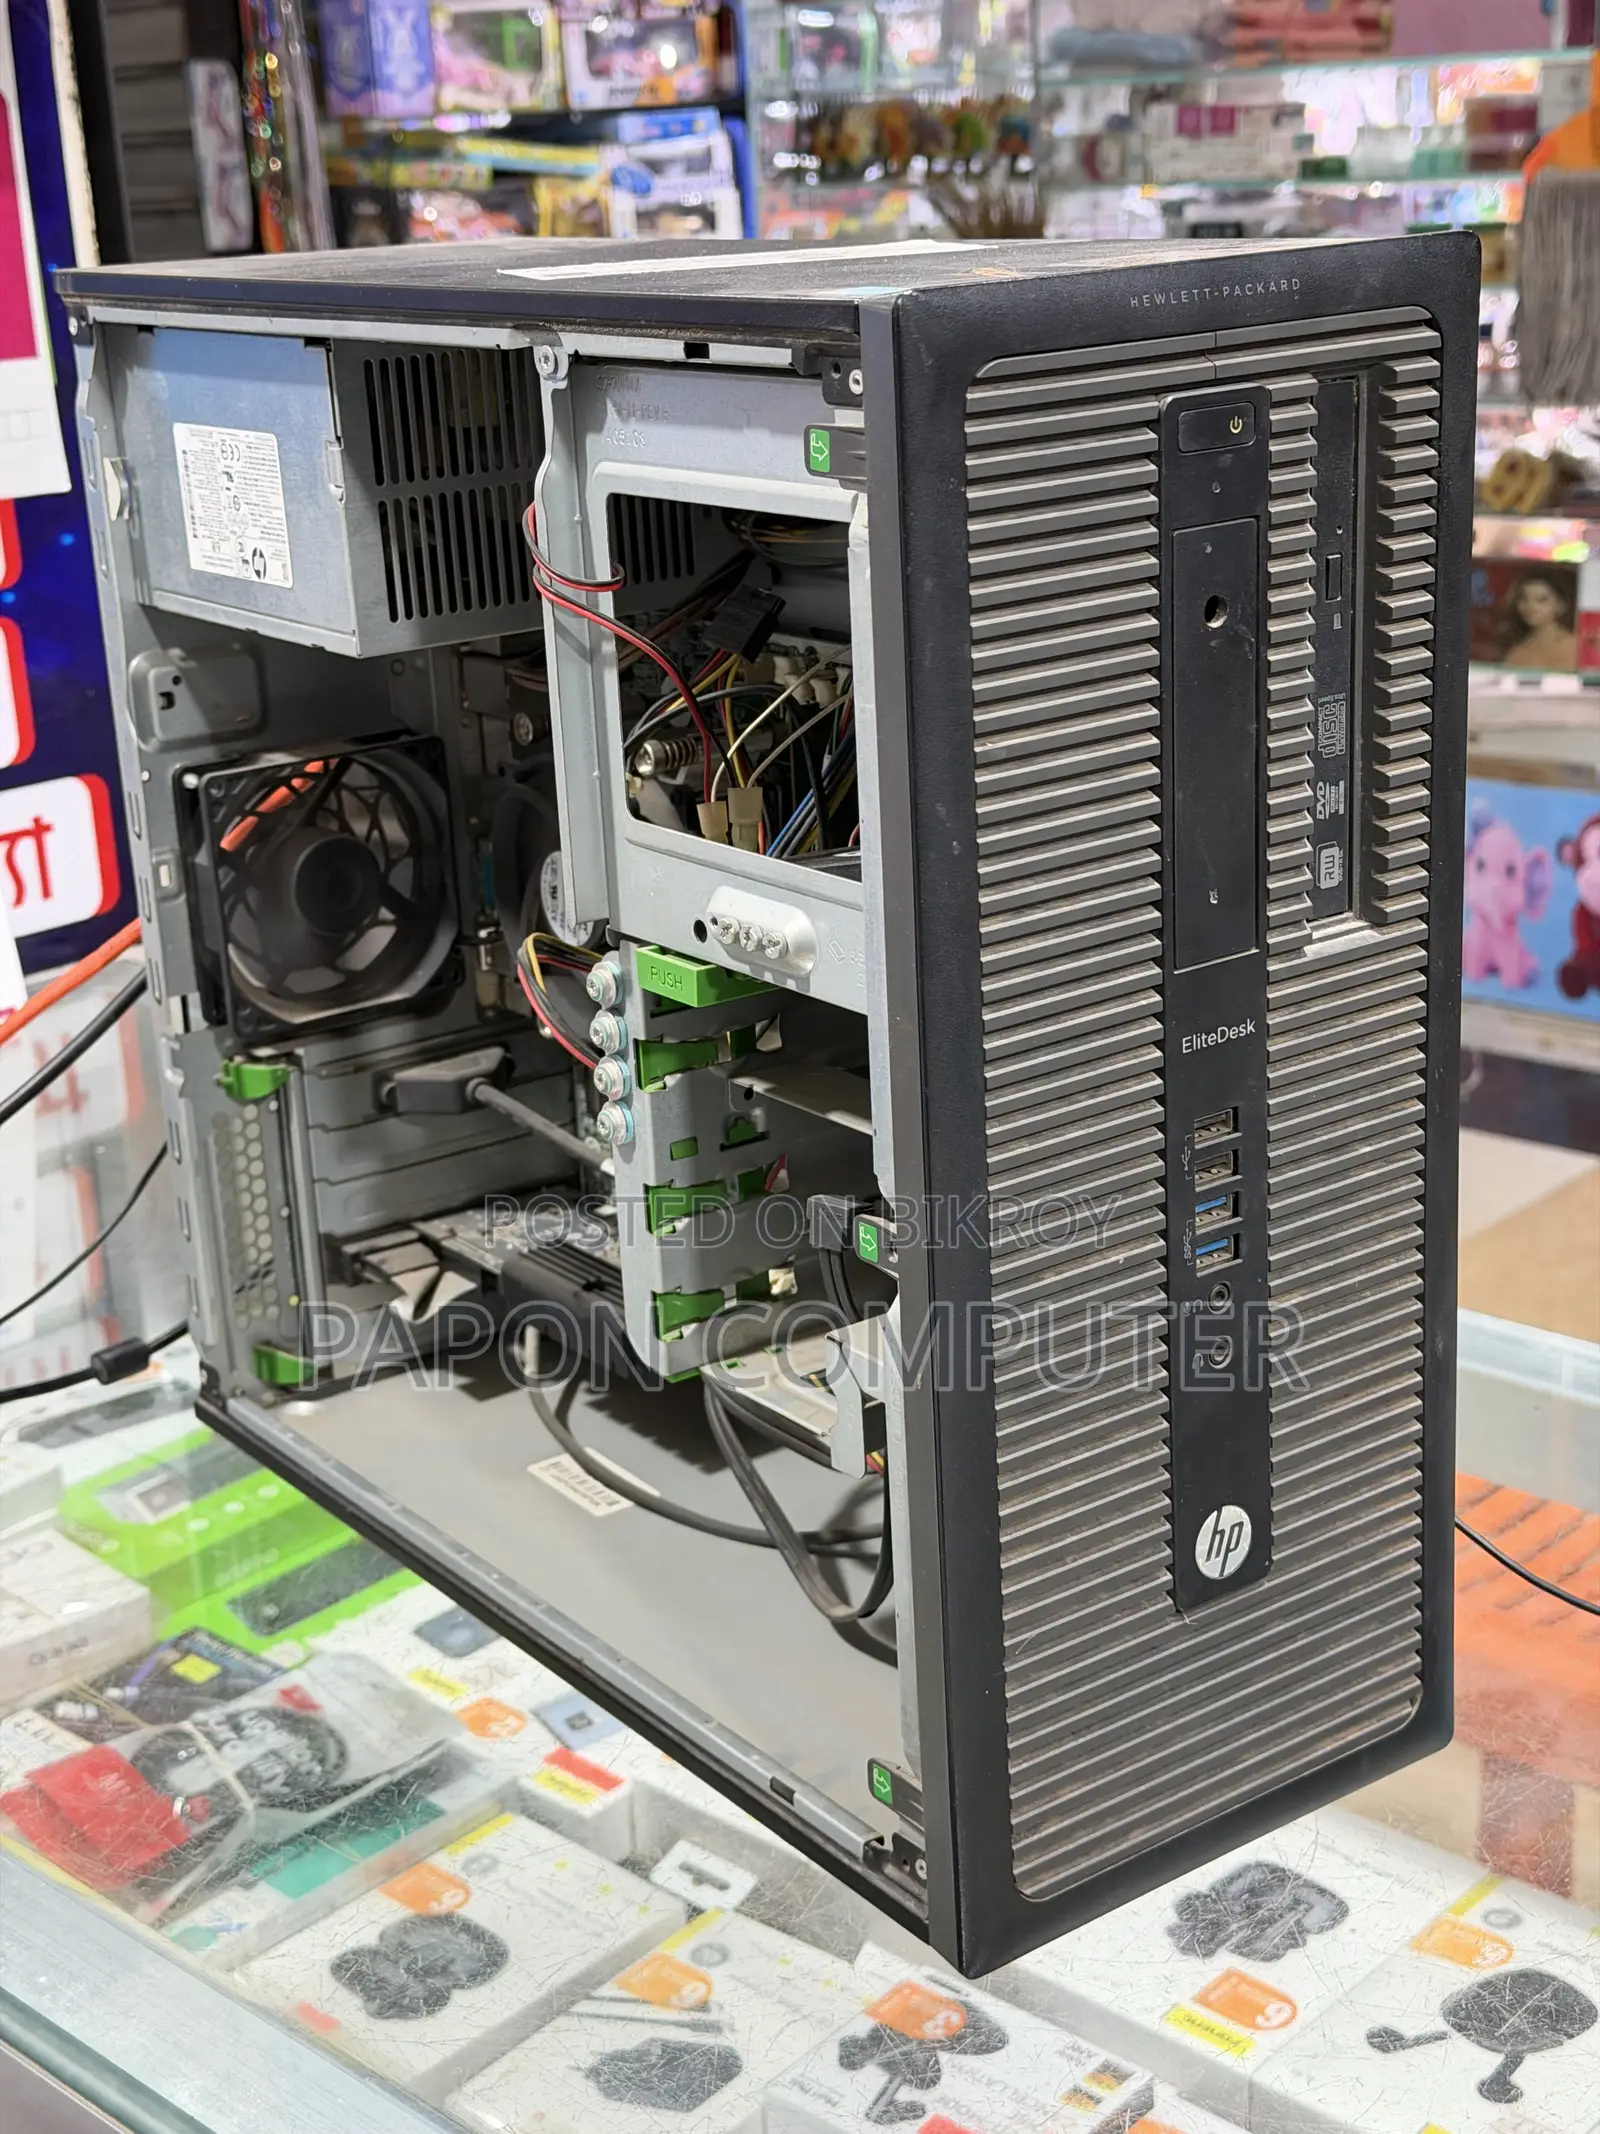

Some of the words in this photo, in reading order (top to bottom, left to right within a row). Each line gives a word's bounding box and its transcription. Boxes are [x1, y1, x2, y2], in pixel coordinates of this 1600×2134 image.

[1130, 278, 1300, 308] HEWLETT-PACKARD
[1316, 781, 1325, 819] DVD
[1324, 855, 1335, 881] RW
[650, 966, 683, 991] PUSH
[1182, 1018, 1256, 1054] EliteDesk
[1203, 1505, 1245, 1578] hp
